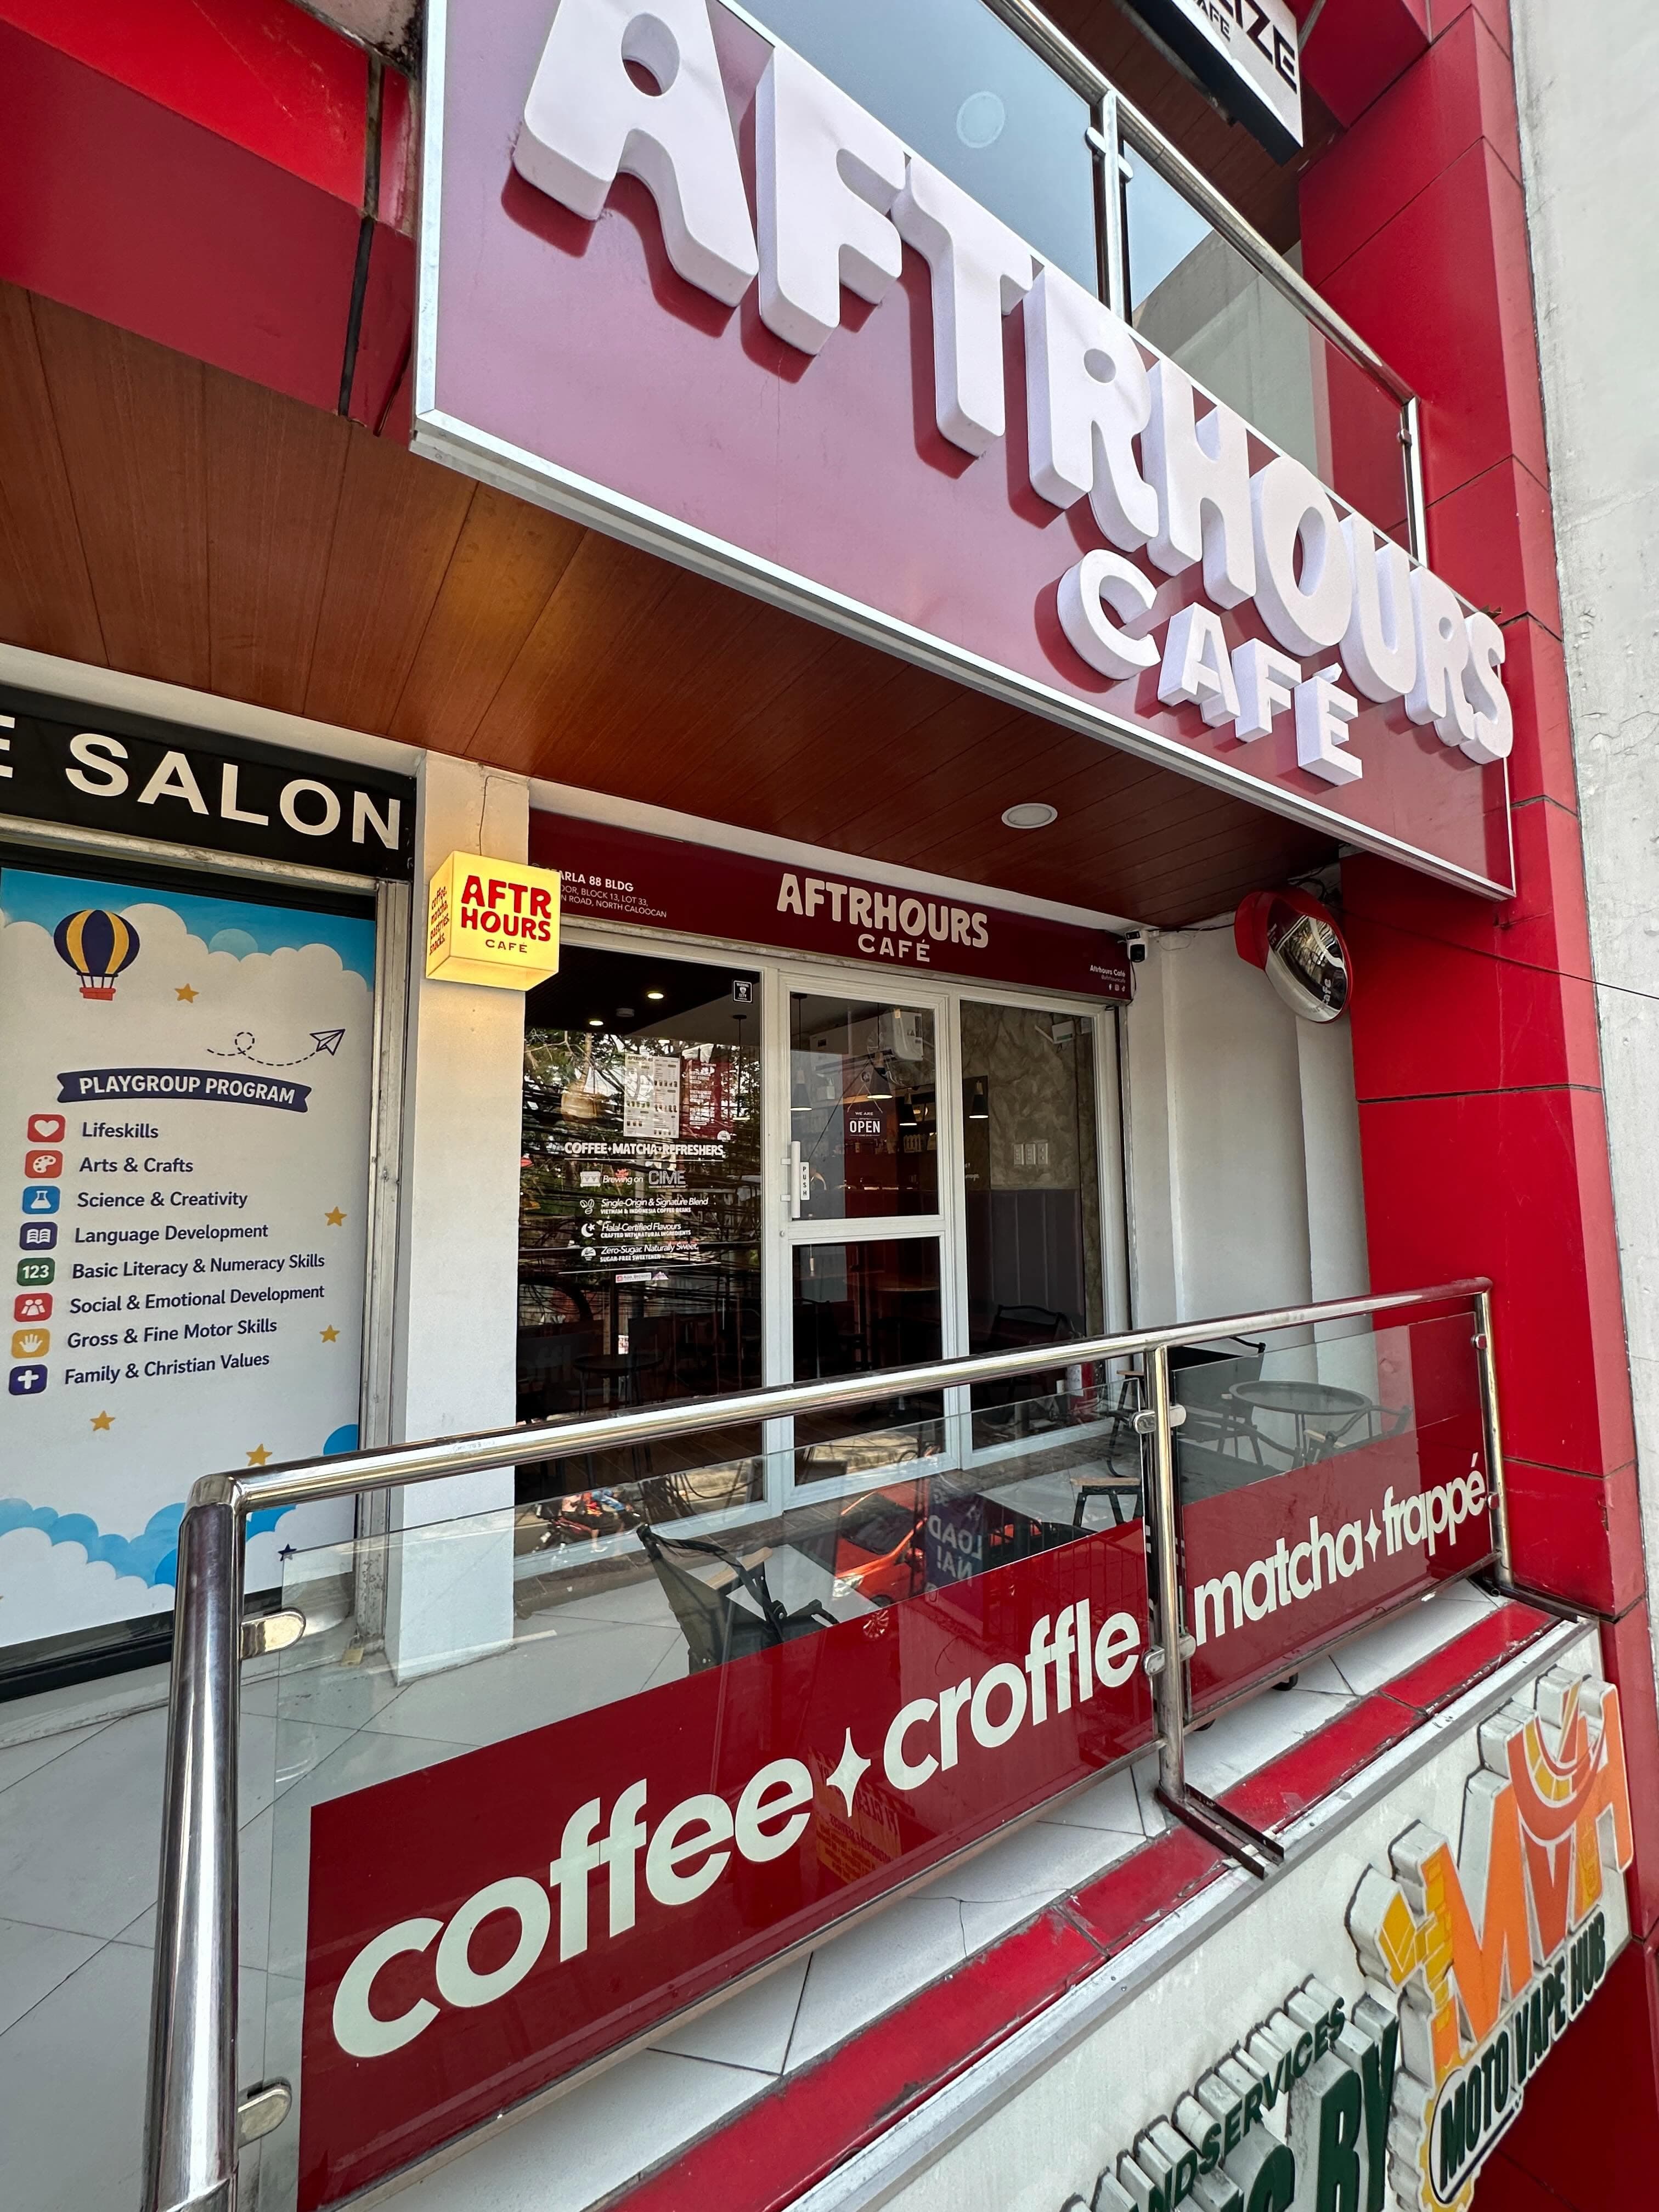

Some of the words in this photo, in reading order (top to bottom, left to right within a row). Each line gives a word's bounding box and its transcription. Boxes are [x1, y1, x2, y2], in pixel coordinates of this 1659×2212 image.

[1194, 0, 1230, 42] AFE
[1218, 0, 1297, 94] IZE
[515, 0, 1513, 765] AFTRHOURS
[1058, 549, 1364, 785] CAFÉ
[65, 733, 401, 850] SALON
[461, 874, 551, 919] AFTR
[581, 888, 608, 899] BLOCK
[610, 893, 620, 902] 13,
[622, 895, 637, 904] LOT
[638, 898, 648, 907] 33,
[589, 876, 602, 887] 88
[605, 878, 634, 892] BLDG
[569, 895, 594, 907] ROAD,
[596, 900, 623, 911] NORTH
[624, 905, 667, 918] CALOOCAN
[776, 873, 989, 949] AFTRHOURS
[461, 906, 551, 942] HOURS
[857, 933, 930, 962] CAFÉ
[79, 1075, 201, 1094] PLAYGROUP
[205, 1079, 295, 1104] PROGRAM
[82, 1121, 159, 1139] Lifeskills
[849, 1120, 881, 1133] OPEN
[565, 1142, 607, 1154] COFFEE
[612, 1143, 658, 1155] MATCHA
[663, 1144, 724, 1156] REFRESHERS
[79, 1157, 117, 1173] Arts
[123, 1158, 138, 1173] &
[144, 1157, 194, 1173] Crafts
[603, 1175, 632, 1186] Brewing
[648, 1170, 686, 1185] CIME
[77, 1192, 145, 1207] Science
[150, 1192, 165, 1207] &
[170, 1190, 248, 1209] Creativity
[601, 1198, 648, 1208] Single-Origin
[656, 1198, 688, 1207] Signature
[689, 1197, 709, 1206] Blend
[75, 1227, 160, 1245] Language
[165, 1224, 268, 1243] Development
[602, 1221, 652, 1232] Halal-Certified
[653, 1222, 681, 1231] Flavours
[644, 1243, 675, 1253] Naturally
[22, 1265, 49, 1279] 123
[72, 1262, 117, 1279] Basic
[123, 1261, 188, 1280] Literacy
[193, 1259, 206, 1273] &
[210, 1256, 285, 1273] Numeracy
[289, 1254, 325, 1268] Skills
[70, 1296, 121, 1314] Social
[127, 1295, 140, 1310] &
[145, 1290, 225, 1310] Emotional
[230, 1285, 325, 1305] Development
[67, 1333, 118, 1348] Gross
[123, 1328, 138, 1344] &
[144, 1325, 178, 1342] Fine
[184, 1322, 233, 1339] Motor
[237, 1318, 277, 1334] Skills
[65, 1366, 121, 1385] Family
[125, 1363, 139, 1379] &
[144, 1358, 216, 1378] Christian
[221, 1353, 270, 1369] Values
[1194, 1515, 1364, 1646] matcha
[1382, 1452, 1486, 1556] frappé
[332, 1757, 814, 2058] coffee
[882, 1598, 1141, 1791] croffle
[1440, 2030, 1509, 2193] MOTO
[1514, 1957, 1566, 2085] VAPE
[1570, 1911, 1606, 2015] HUB
[1198, 1997, 1345, 2174] SERVICES
